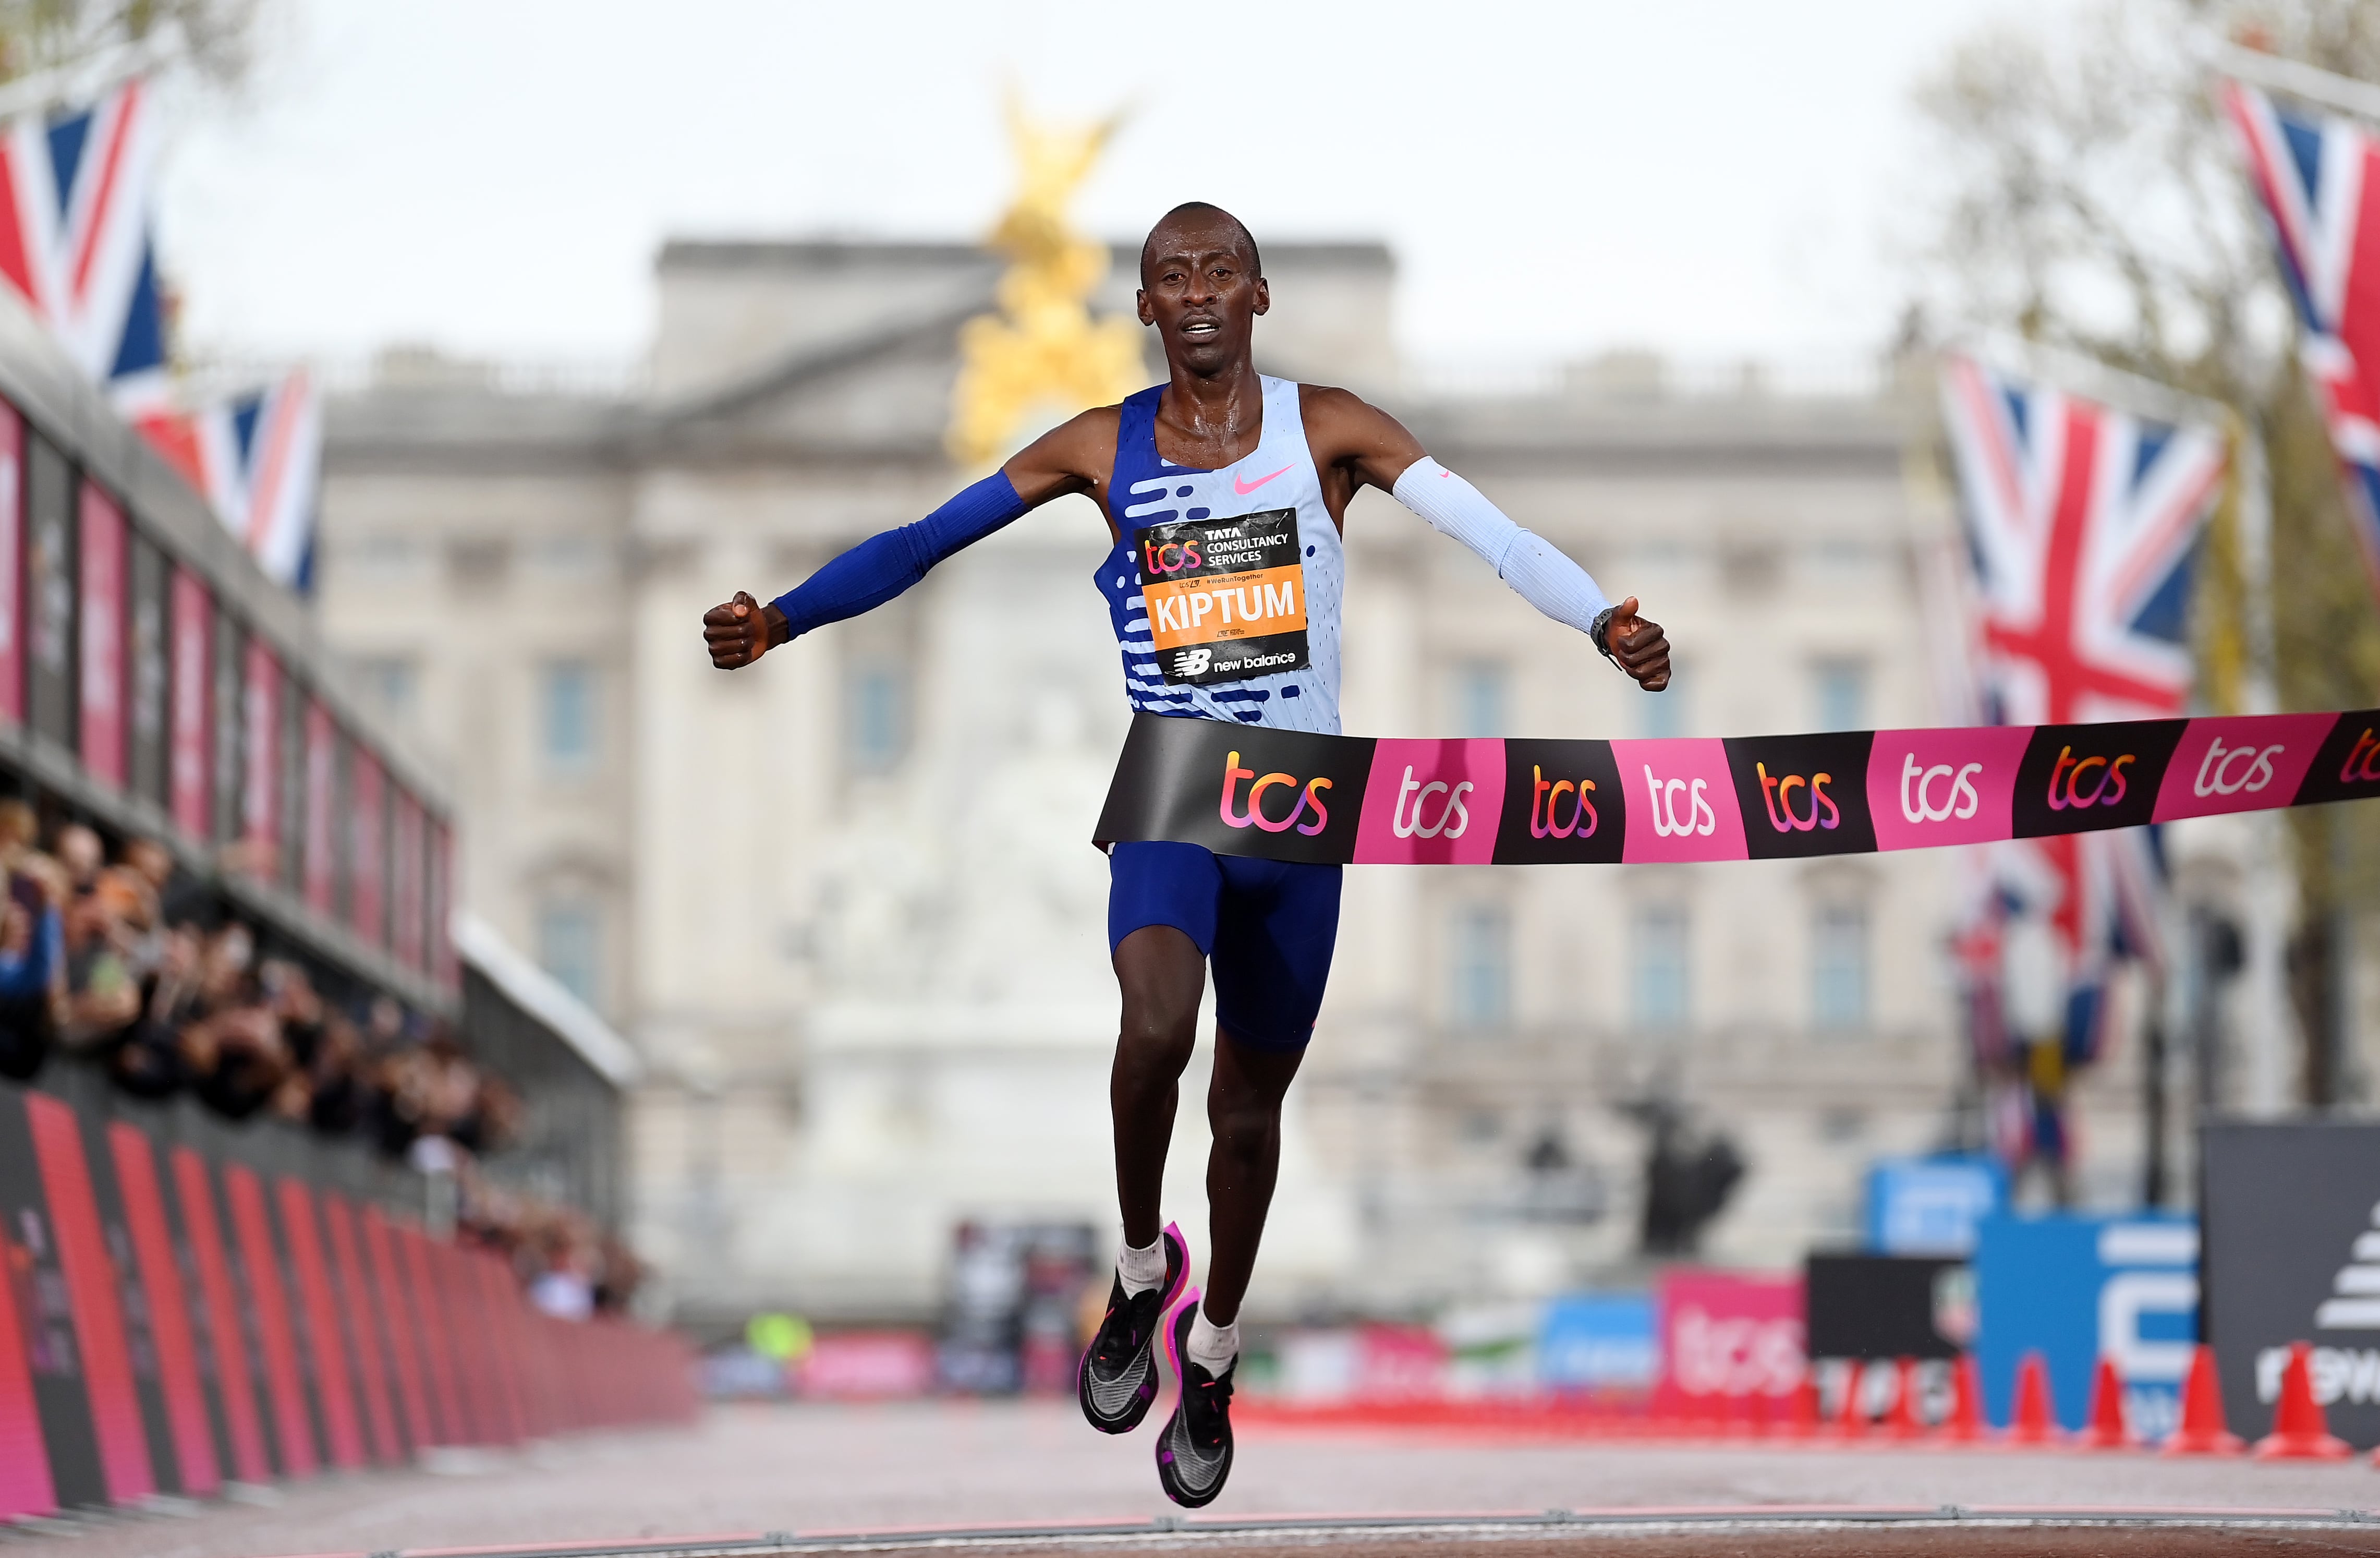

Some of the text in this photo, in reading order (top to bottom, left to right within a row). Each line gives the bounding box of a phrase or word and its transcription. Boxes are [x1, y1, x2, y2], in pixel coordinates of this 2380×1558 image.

[1205, 527, 1241, 540] TATA
[1207, 533, 1289, 553] CONSULTANCY
[1145, 540, 1201, 574] tcs
[1208, 550, 1262, 566] SERVICES
[1207, 574, 1263, 584] #WeRunTogether
[1155, 581, 1295, 633] KIPTUM
[1213, 661, 1242, 672] new
[1244, 653, 1296, 669] balance
[1220, 728, 2380, 838] tcs tcs tcs tcs tcs tcs tcs tcs tc
